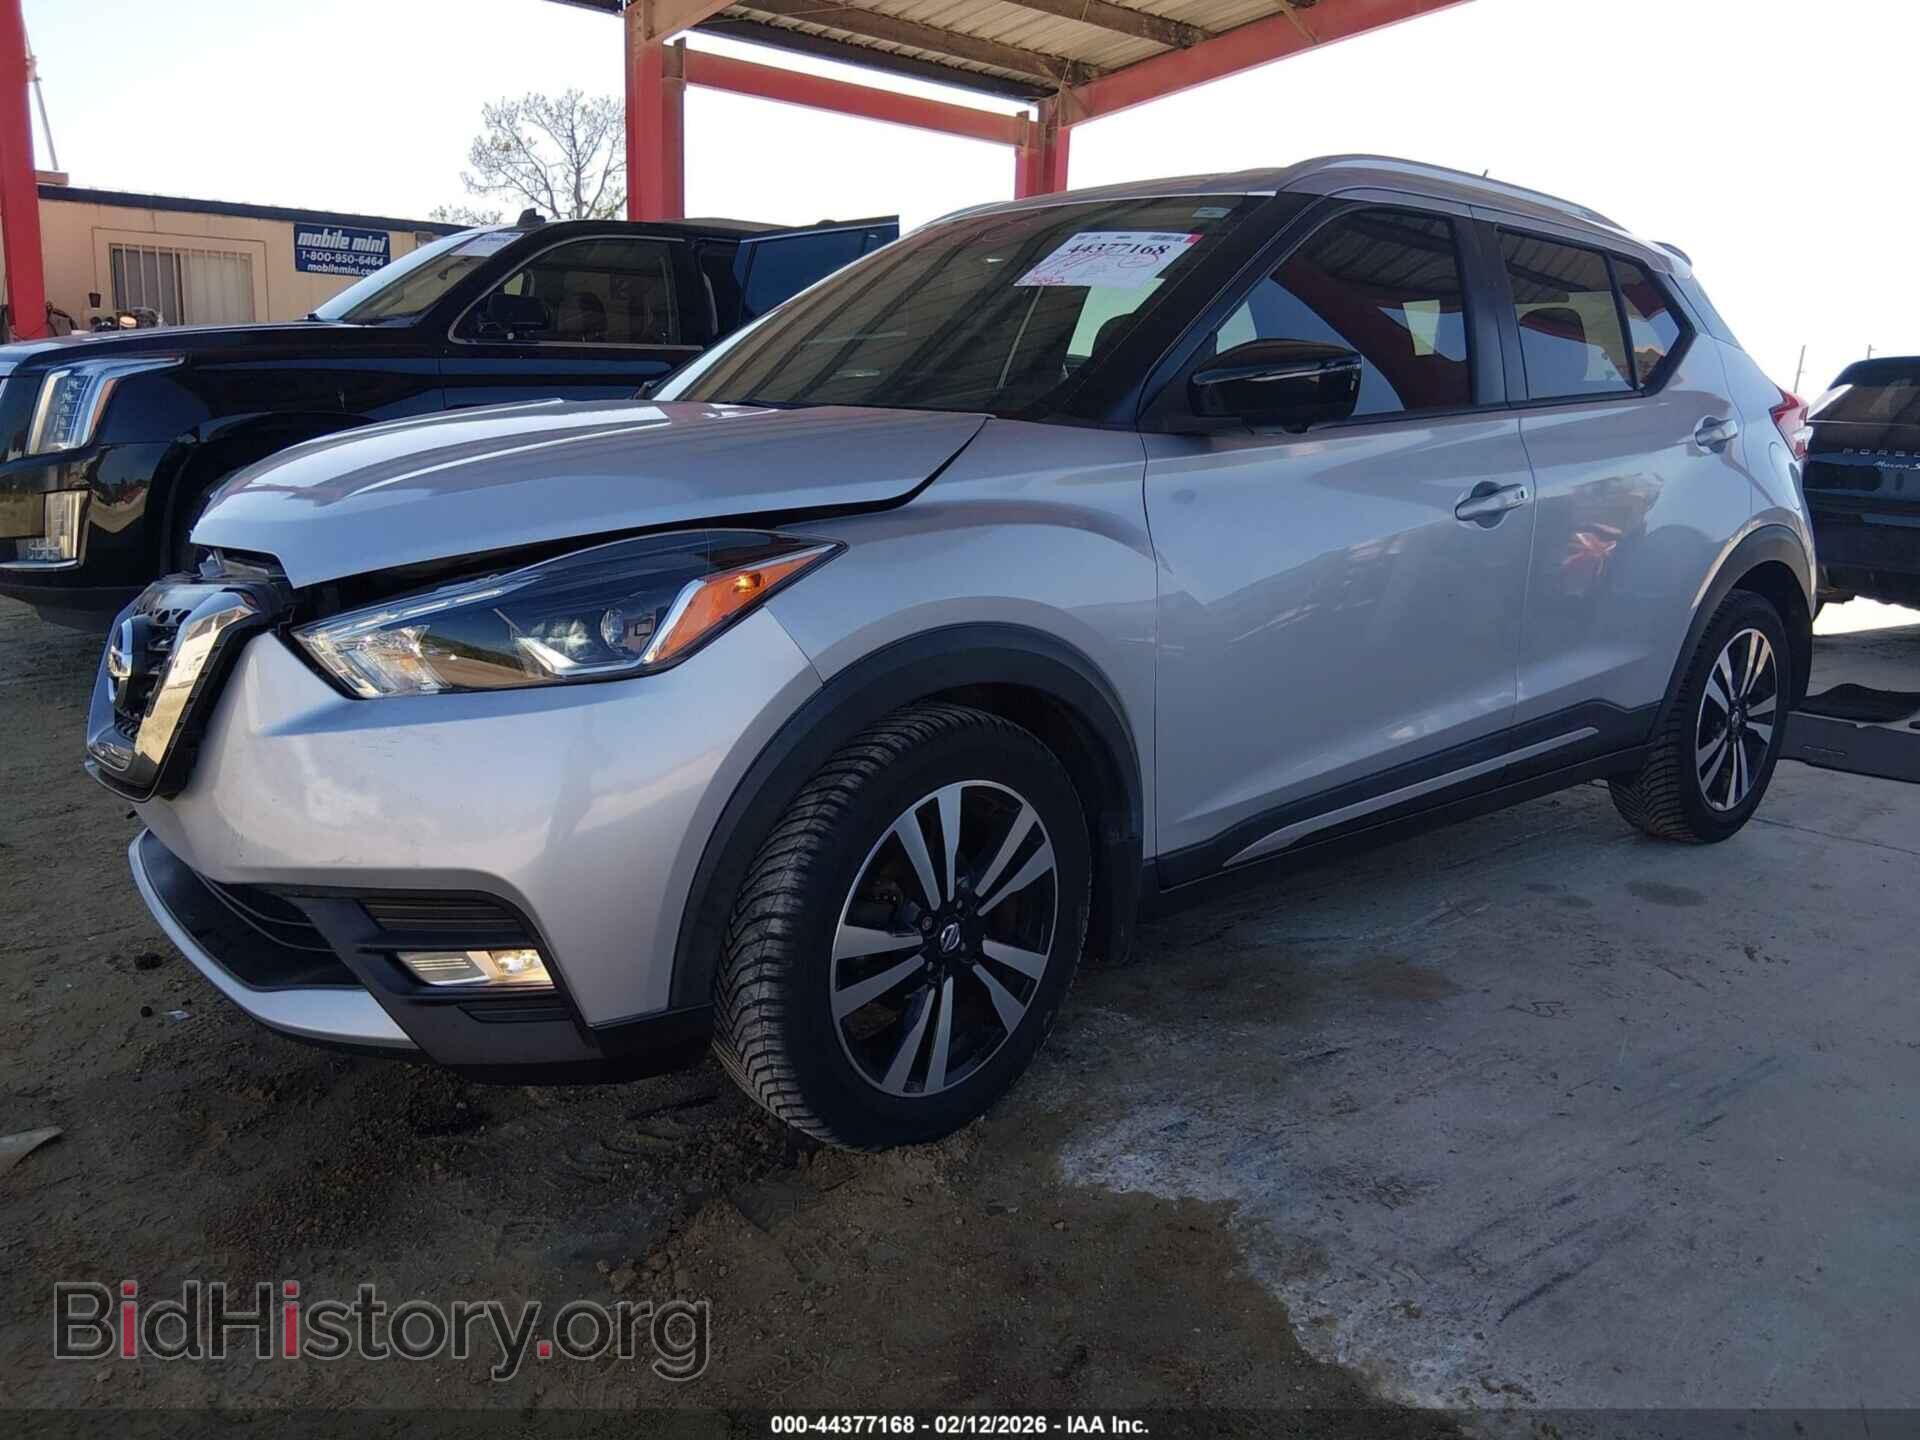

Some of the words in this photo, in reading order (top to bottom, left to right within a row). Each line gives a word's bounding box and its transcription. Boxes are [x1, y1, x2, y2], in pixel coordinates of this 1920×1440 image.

[297, 228, 350, 249] mobile
[351, 236, 388, 253] mini
[1068, 242, 1171, 256] 44377168
[301, 250, 384, 266] 1-800-950-6464
